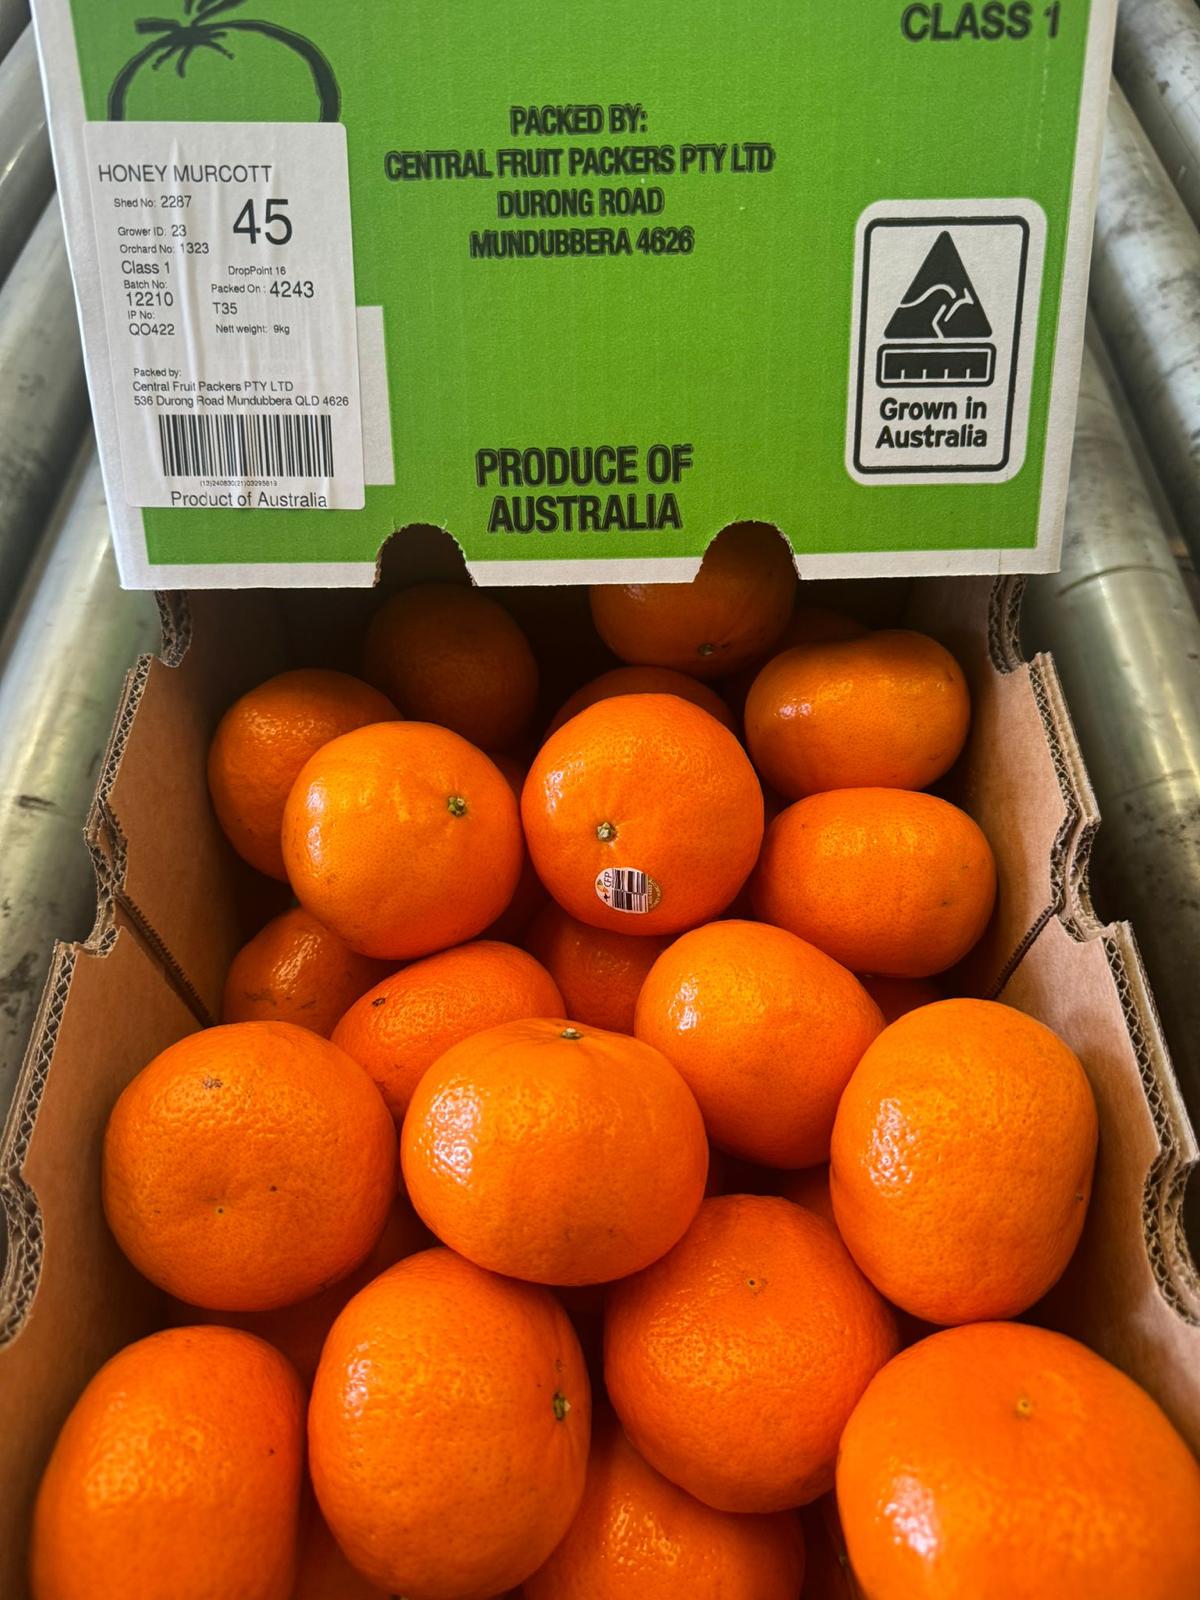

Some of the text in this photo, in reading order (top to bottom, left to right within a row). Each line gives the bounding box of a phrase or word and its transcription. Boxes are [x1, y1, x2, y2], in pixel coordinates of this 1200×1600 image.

[901, 1, 1061, 42] CLASS 1
[510, 104, 648, 136] PACKED BY:
[384, 142, 776, 182] CENTRAL FRUIT PACKERS PTY LTD
[98, 164, 273, 183] HONEY MURCOTT
[113, 195, 192, 208] Shed No: 2287
[497, 187, 665, 218] DURONG ROAD
[232, 198, 293, 246] 45
[117, 224, 187, 237] Grower ID: 23
[120, 242, 210, 255] Orchard No: 1323
[470, 226, 695, 259] MUNDUBBERA 4626
[121, 260, 170, 275] Class 1
[227, 265, 287, 277] DropPoint 16
[123, 279, 168, 290] Batch No:
[210, 283, 245, 294] Packed
[269, 280, 315, 299] 4243
[126, 291, 174, 307] 12210
[127, 309, 156, 320] IP No:
[212, 302, 238, 315] T35
[215, 324, 290, 336] Nett weight: 9kg
[133, 367, 182, 379] Packed by:
[132, 380, 294, 392] Central Fruit Packers PTY LTD
[134, 395, 349, 408] 536 Durong Road Mundubbera QLD 4626
[879, 395, 988, 421] Grown in
[875, 424, 989, 449] Australia
[475, 443, 694, 487] PRODUCE OF
[170, 490, 328, 508] Product of Australia
[486, 493, 684, 533] AUSTRALIA
[603, 871, 612, 887] CFP
